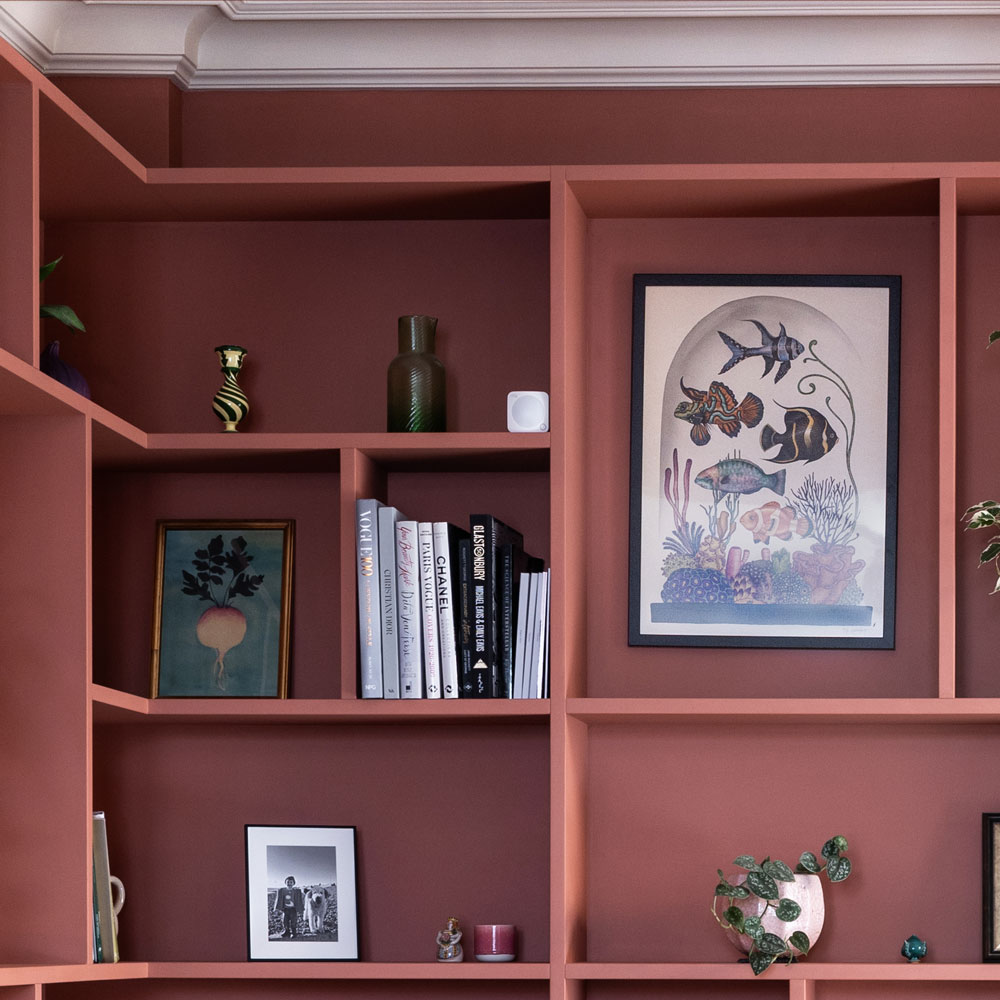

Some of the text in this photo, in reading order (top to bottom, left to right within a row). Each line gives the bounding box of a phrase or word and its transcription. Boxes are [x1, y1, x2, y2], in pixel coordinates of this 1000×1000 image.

[359, 510, 373, 557] VOGUE
[360, 557, 374, 576] 100
[422, 542, 433, 574] PARIS
[473, 525, 485, 581] GLASTONBURY
[424, 576, 435, 612] VOGUE
[436, 556, 449, 615] CHANEL
[475, 585, 484, 605] MICHAEL
[384, 569, 393, 636] CHRISTIAN DIOR
[475, 606, 484, 619] EAVIS
[475, 624, 485, 638] EMILY
[476, 639, 485, 652] EAVIS
